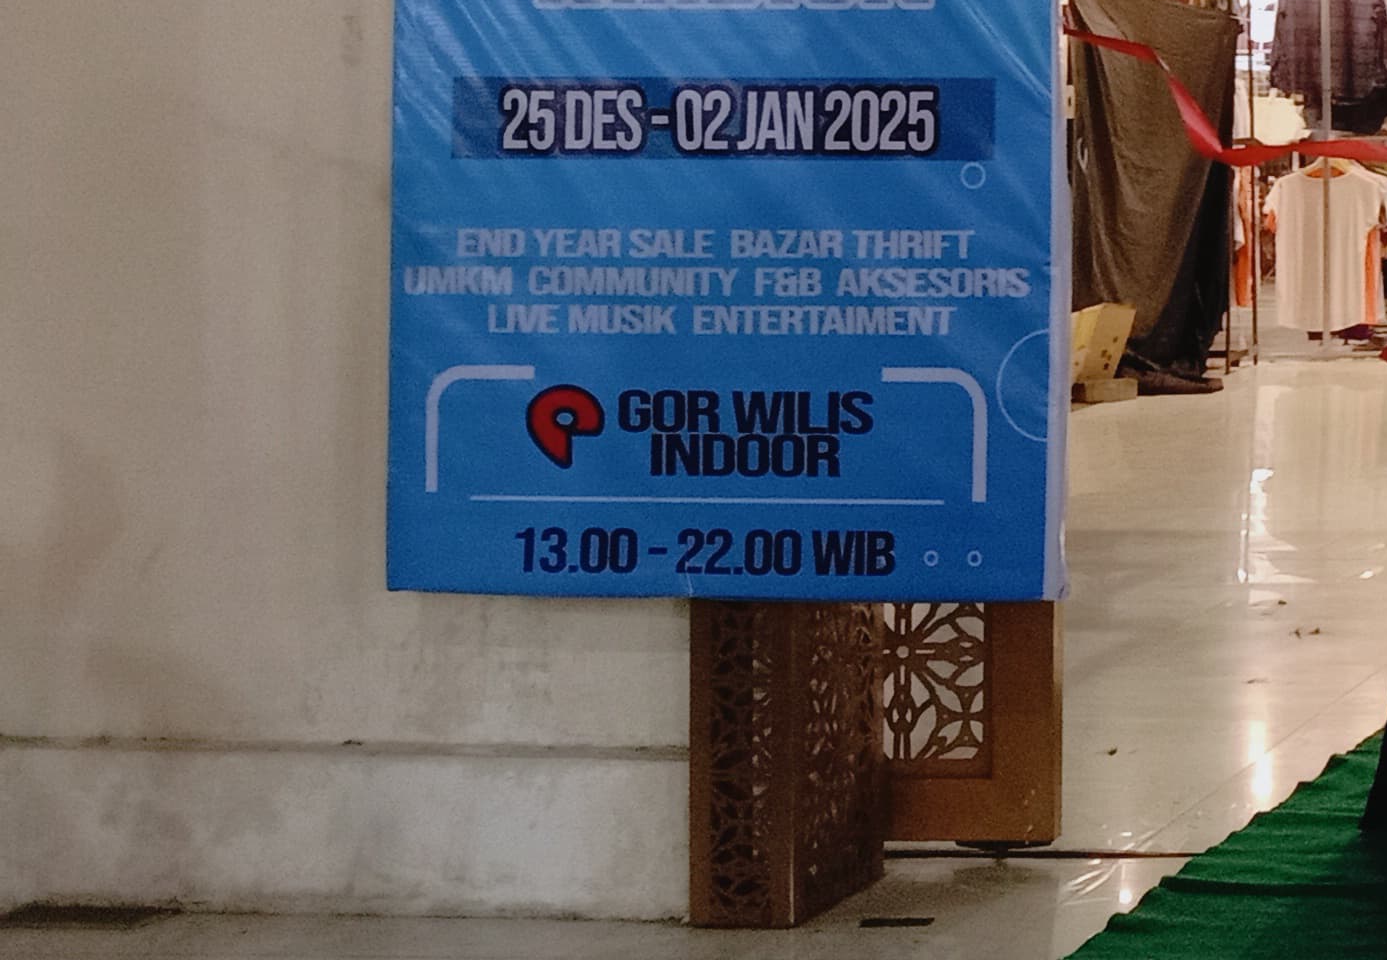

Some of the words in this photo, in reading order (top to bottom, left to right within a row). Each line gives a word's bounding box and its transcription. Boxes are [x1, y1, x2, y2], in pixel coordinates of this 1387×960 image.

[503, 89, 555, 151] 25
[565, 89, 643, 152] DES
[675, 90, 735, 152] 02
[738, 90, 815, 152] JAN
[824, 90, 936, 152] 2025
[457, 229, 525, 258] END
[532, 229, 621, 258] YEAR
[629, 229, 714, 258] SALE
[730, 230, 844, 258] BAZAR
[855, 231, 974, 258] THRIFT
[404, 265, 513, 296] UMKM
[528, 266, 739, 296] COMMUNITY
[754, 267, 822, 296] F&B
[836, 267, 1031, 297] AKSESORIS
[488, 305, 558, 334] LIVE
[568, 305, 677, 335] MUSIK
[692, 305, 957, 336] ENTERTAIMENT
[618, 390, 718, 435] GOR
[733, 391, 874, 435] WILIS
[650, 433, 841, 478] INDOOR
[514, 527, 638, 574] 13.00
[676, 529, 802, 576] 22.00
[812, 530, 897, 577] WIB
